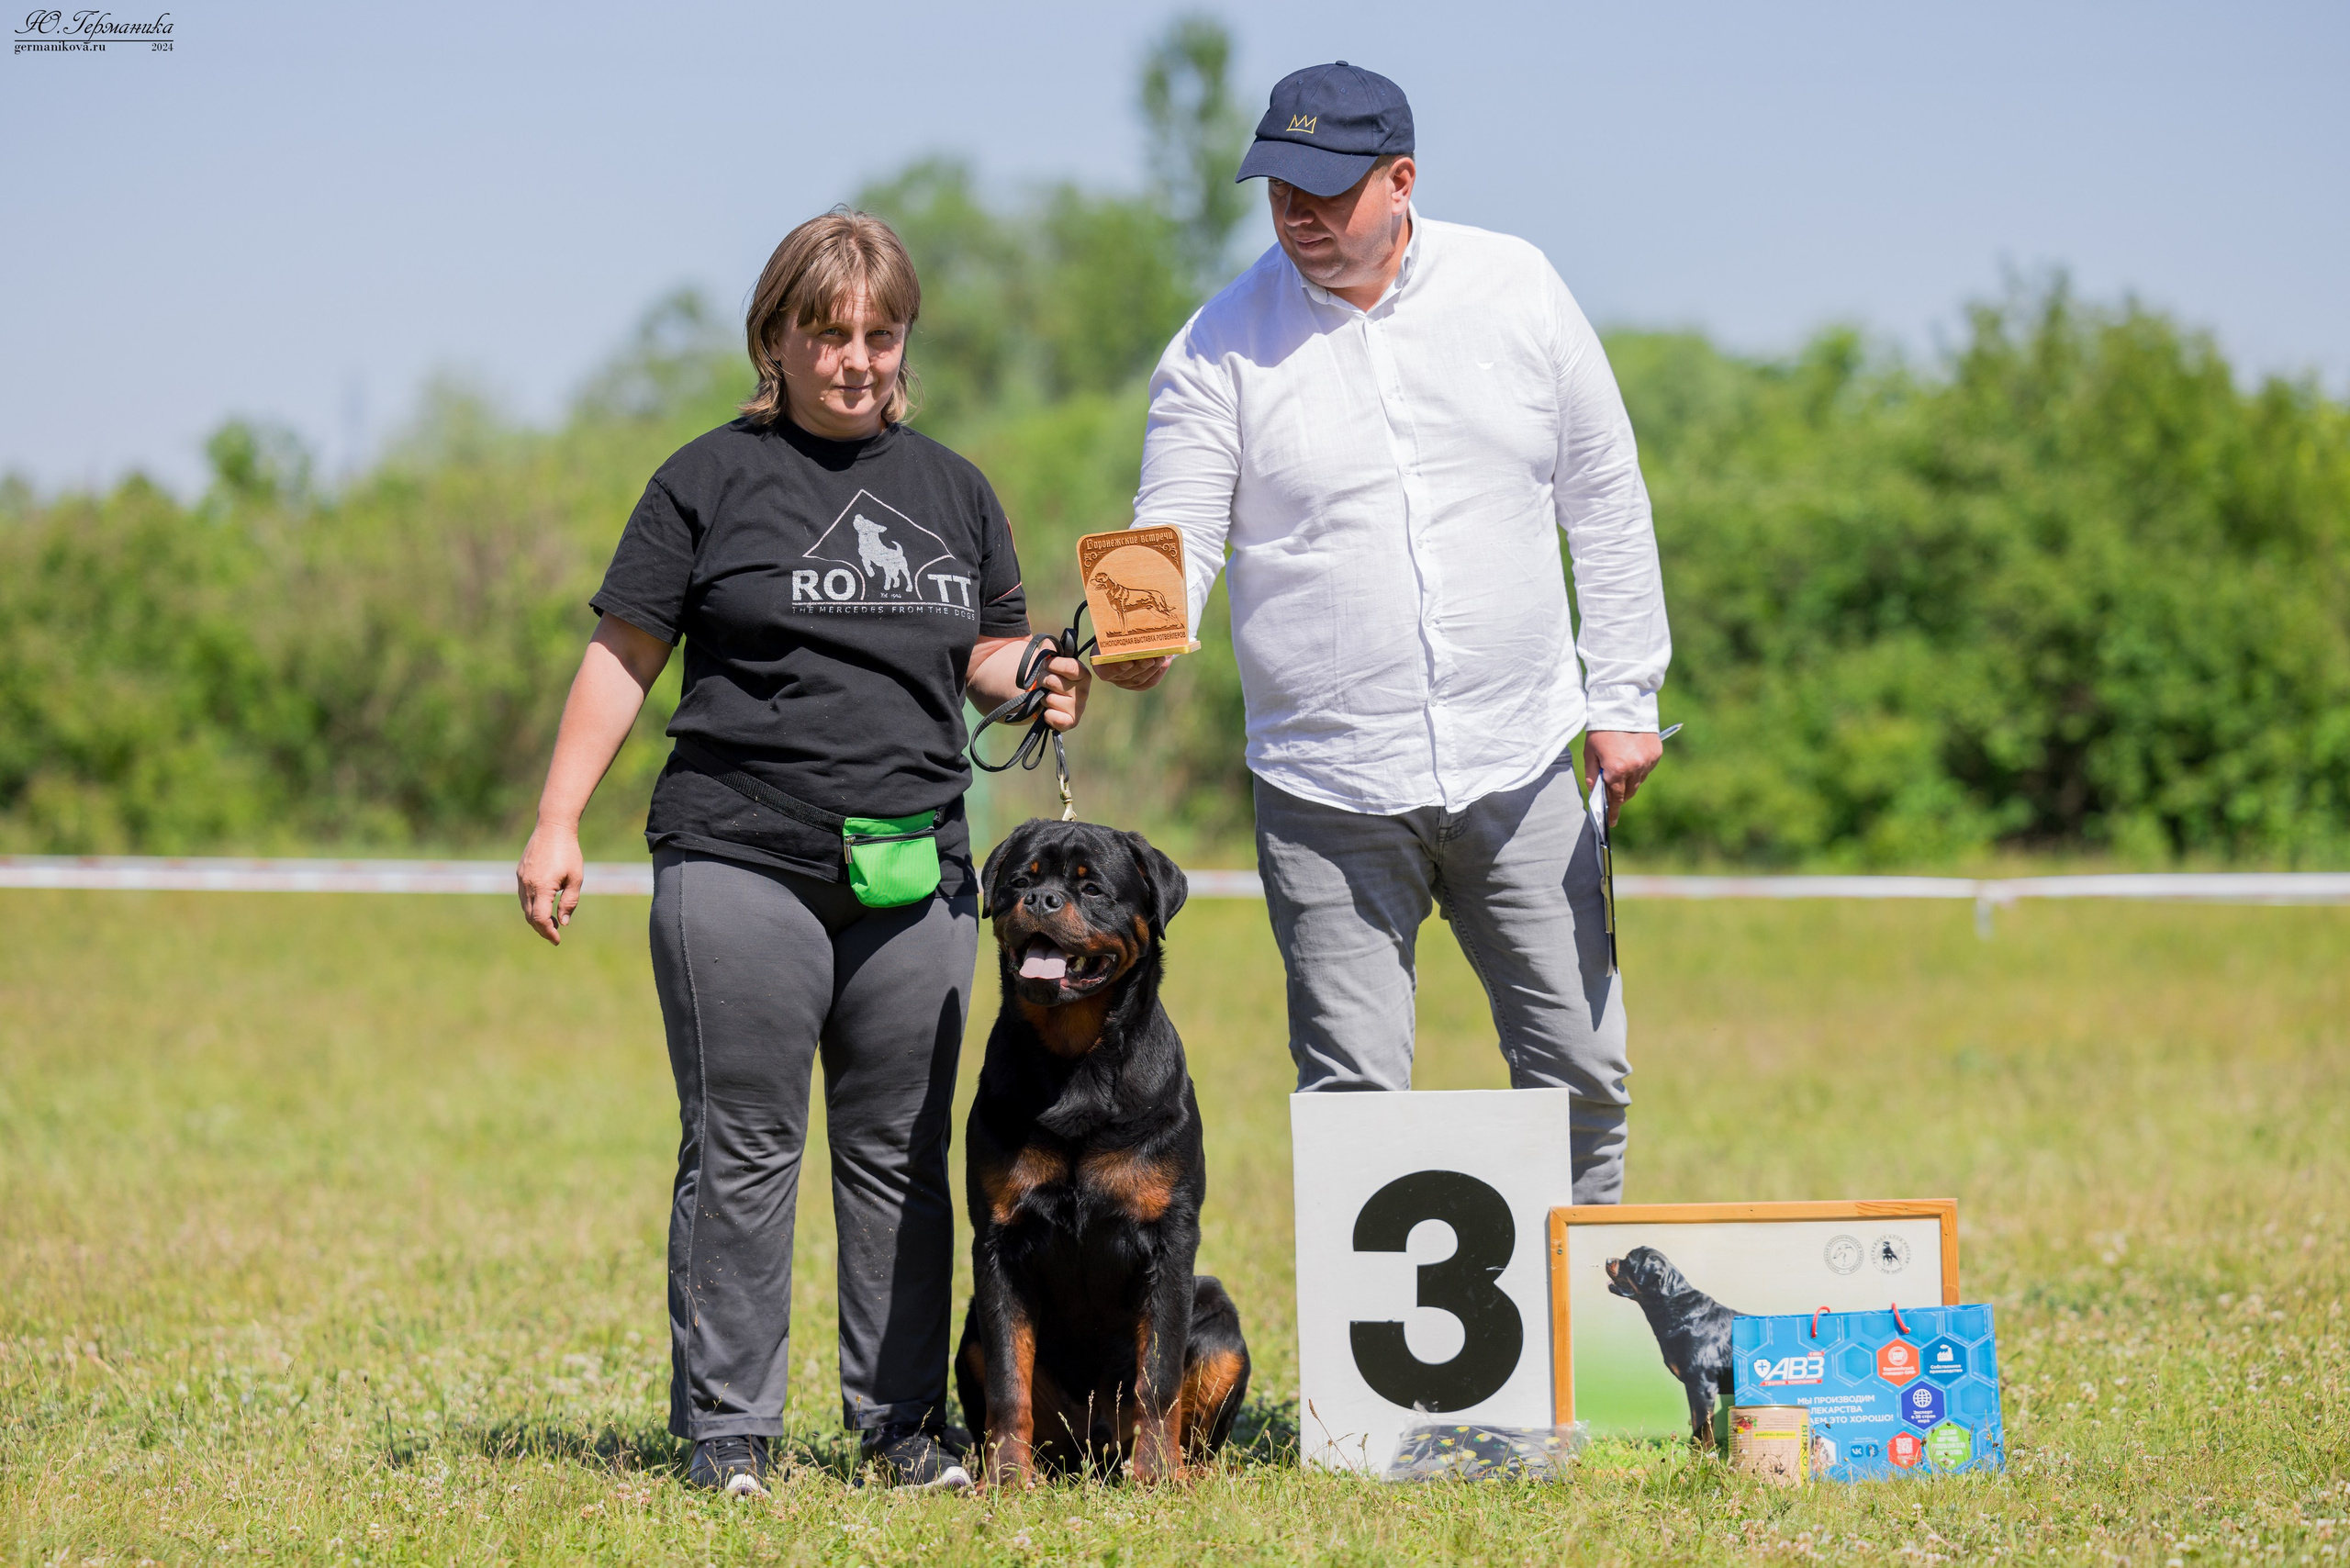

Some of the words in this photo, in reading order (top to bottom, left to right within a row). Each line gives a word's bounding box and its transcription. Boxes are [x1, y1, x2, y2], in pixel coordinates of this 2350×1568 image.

[1086, 537, 1138, 551] Воронежские
[1140, 532, 1173, 544] встречи
[792, 568, 856, 601] RO
[819, 606, 884, 614] MERCEDES
[891, 606, 923, 614] FROM
[928, 607, 949, 615] THE
[955, 609, 976, 621] DOGS
[1135, 634, 1157, 644] ВЫСТАВКА
[1157, 631, 1186, 642] РОТВЕЙЛЕРОВ
[1349, 1170, 1524, 1414] 3
[1814, 1394, 1875, 1405] ПРОИЗВОДИМ
[1810, 1406, 1863, 1415] ЛЕКАРСТВА
[1809, 1417, 1828, 1425] АЕМ
[1850, 1414, 1894, 1423] ХОРОШО!
